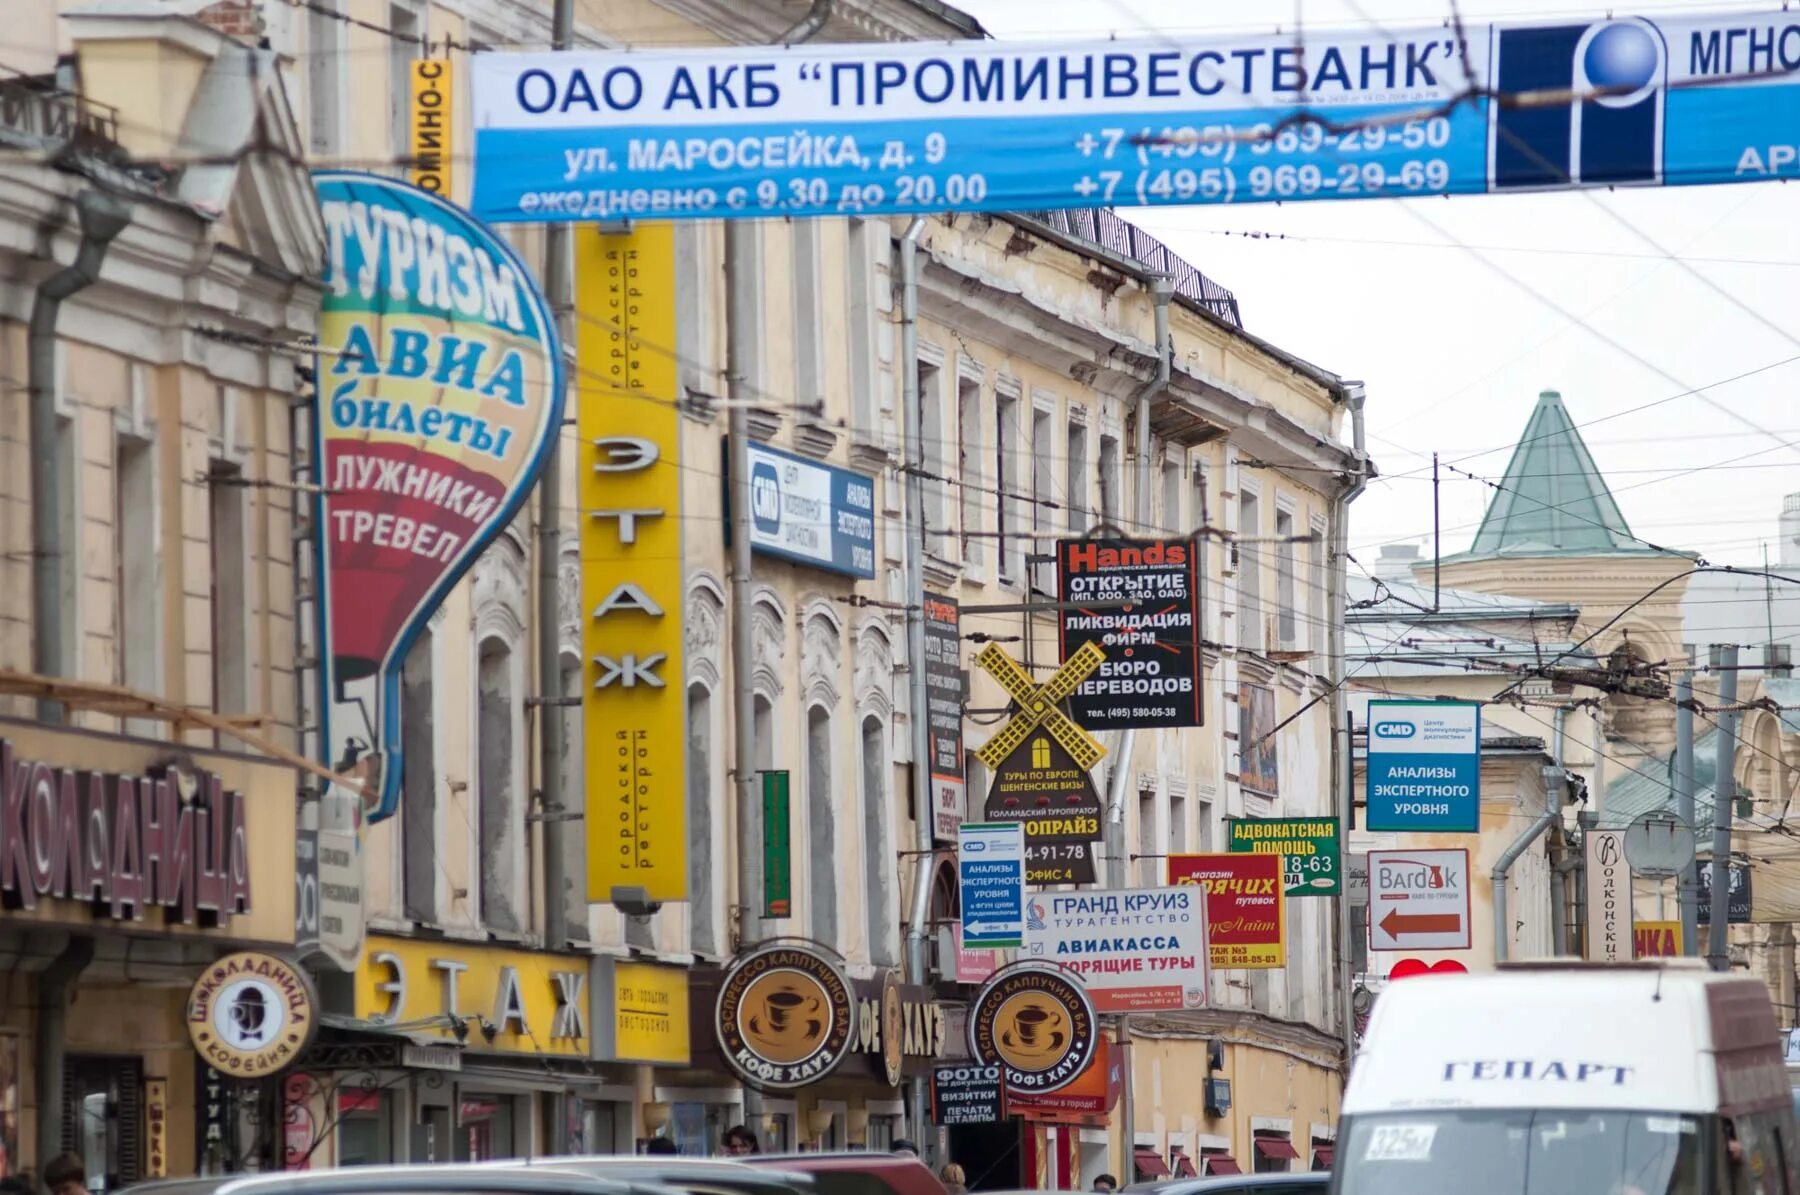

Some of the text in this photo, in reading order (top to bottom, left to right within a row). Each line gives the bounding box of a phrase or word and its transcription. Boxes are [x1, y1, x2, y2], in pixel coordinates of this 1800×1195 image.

[516, 66, 642, 114] ОАО
[664, 64, 779, 111] АКБ
[417, 62, 443, 196] ОМИНО-С
[1076, 116, 1450, 166] +7 (495) 969-29-50
[564, 130, 947, 180] ул. МАРОСЕЙКА, д. 9
[1735, 144, 1800, 176] АР
[1073, 159, 1450, 205] +7 (495) 969-29-69
[519, 173, 986, 214] ежедневно с 9.30 до 20.00
[322, 200, 525, 331] ТУРИЗМ
[331, 324, 526, 407] АВИА
[331, 379, 513, 460] билеты
[333, 454, 506, 524] ЛУЖНИКИ
[332, 509, 460, 563] ТРЕВЕЛ
[1069, 539, 1186, 573] Hands
[1071, 574, 1184, 592] ОТКРЫТИЕ
[1158, 589, 1187, 599] ОАО)
[1066, 613, 1191, 630] ЛИКВИДАЦИЯ
[1103, 632, 1156, 646] ФИРМ
[1100, 661, 1160, 677] БЮРО
[1087, 707, 1176, 718] тел. (495) 580-05-38
[1377, 723, 1413, 736] CMD
[1004, 770, 1079, 781] ТУРЫ ПО ЕВРОПЕ
[1388, 766, 1456, 778] АНАЛИЗЫ
[1000, 781, 1084, 792] ШЕНГЕНСКИЕ ВИЗЫ
[1374, 785, 1469, 797] ЭКСПЕРТНОГО
[989, 807, 1098, 818] ГОЛЛАНДСКИЙ ТУРОПЕРАТОР
[1394, 803, 1449, 815] УРОВНЯ
[1025, 816, 1098, 836] ОПРАЙЗ
[1234, 823, 1334, 839] АДВОКАТСКАЯ
[1253, 841, 1316, 856] ПОМОЩЬ
[969, 864, 1013, 873] АНАЛИЗЫ
[1026, 869, 1072, 880] ОФИС 4
[1192, 871, 1233, 879] магазин
[974, 889, 1010, 899] УРОВНЯ
[1236, 896, 1275, 907] путевок
[1595, 833, 1621, 961] Волконски
[1053, 892, 1189, 915] ГРАНД КРУИЗ
[1055, 913, 1190, 928] ТУРАГЕНТСТВО
[1056, 936, 1180, 954] АВИАКАССА
[1059, 956, 1195, 974] ГОРЯЩИЕ ТУРЫ
[366, 951, 586, 1038] ЭТАЖ
[722, 951, 850, 1037] ЭСПРЕССО КАППУЧИНО БАР
[977, 976, 1087, 1059] ЭСПРЕССО КАППУЧИНО БАР
[903, 1002, 946, 1058] ХАУЗ
[736, 1048, 834, 1081] КОФЕ ХАУЗ
[937, 1066, 1000, 1081] ФОТО
[1047, 1051, 1080, 1084] ХАУЗ
[1441, 1059, 1636, 1086] ГЕПАРТ
[941, 1090, 996, 1102] ВИЗИТКИ
[944, 1113, 996, 1124] ШТАМПЫ
[947, 1105, 992, 1116] ПЕЧАТИ
